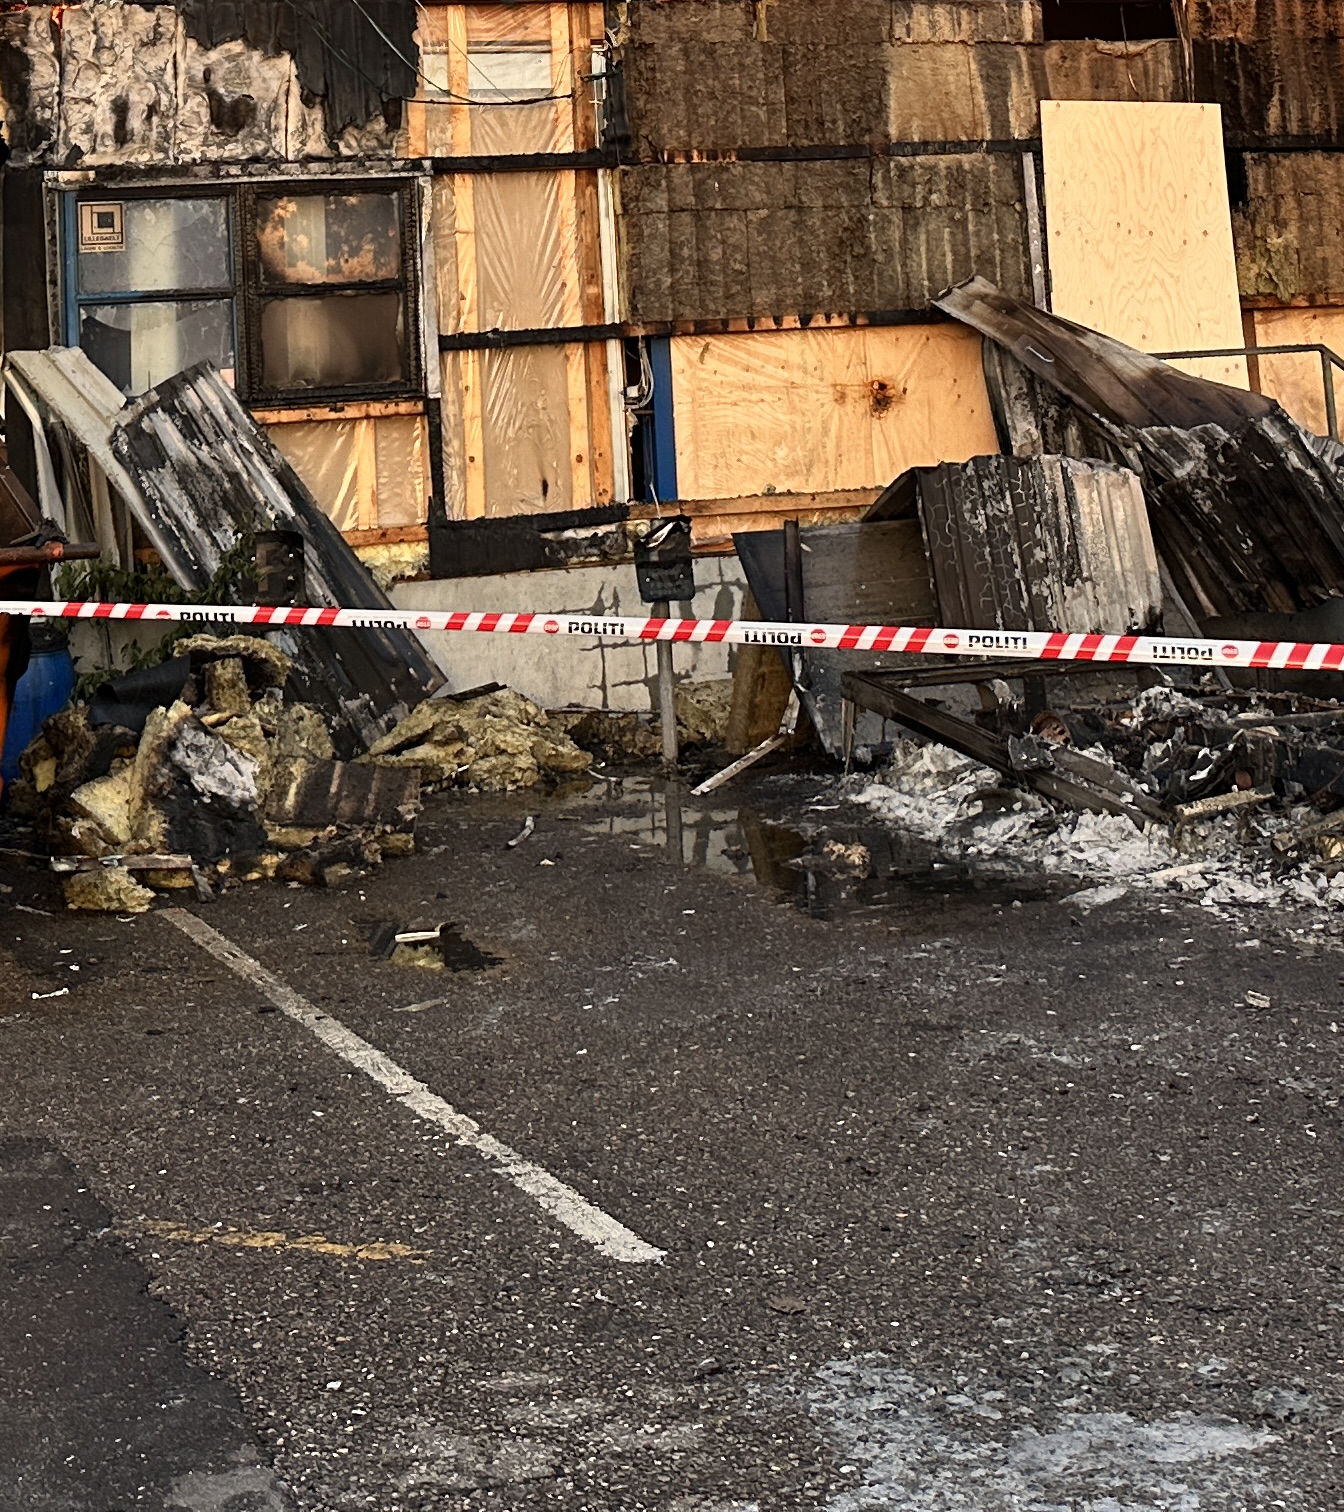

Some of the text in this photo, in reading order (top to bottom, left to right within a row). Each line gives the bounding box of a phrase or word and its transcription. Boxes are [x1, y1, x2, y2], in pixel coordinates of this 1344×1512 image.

[568, 621, 625, 635] POLITI
[744, 630, 802, 644] POLITI
[968, 635, 1028, 649] POLITI
[1152, 645, 1214, 660] POLITI
